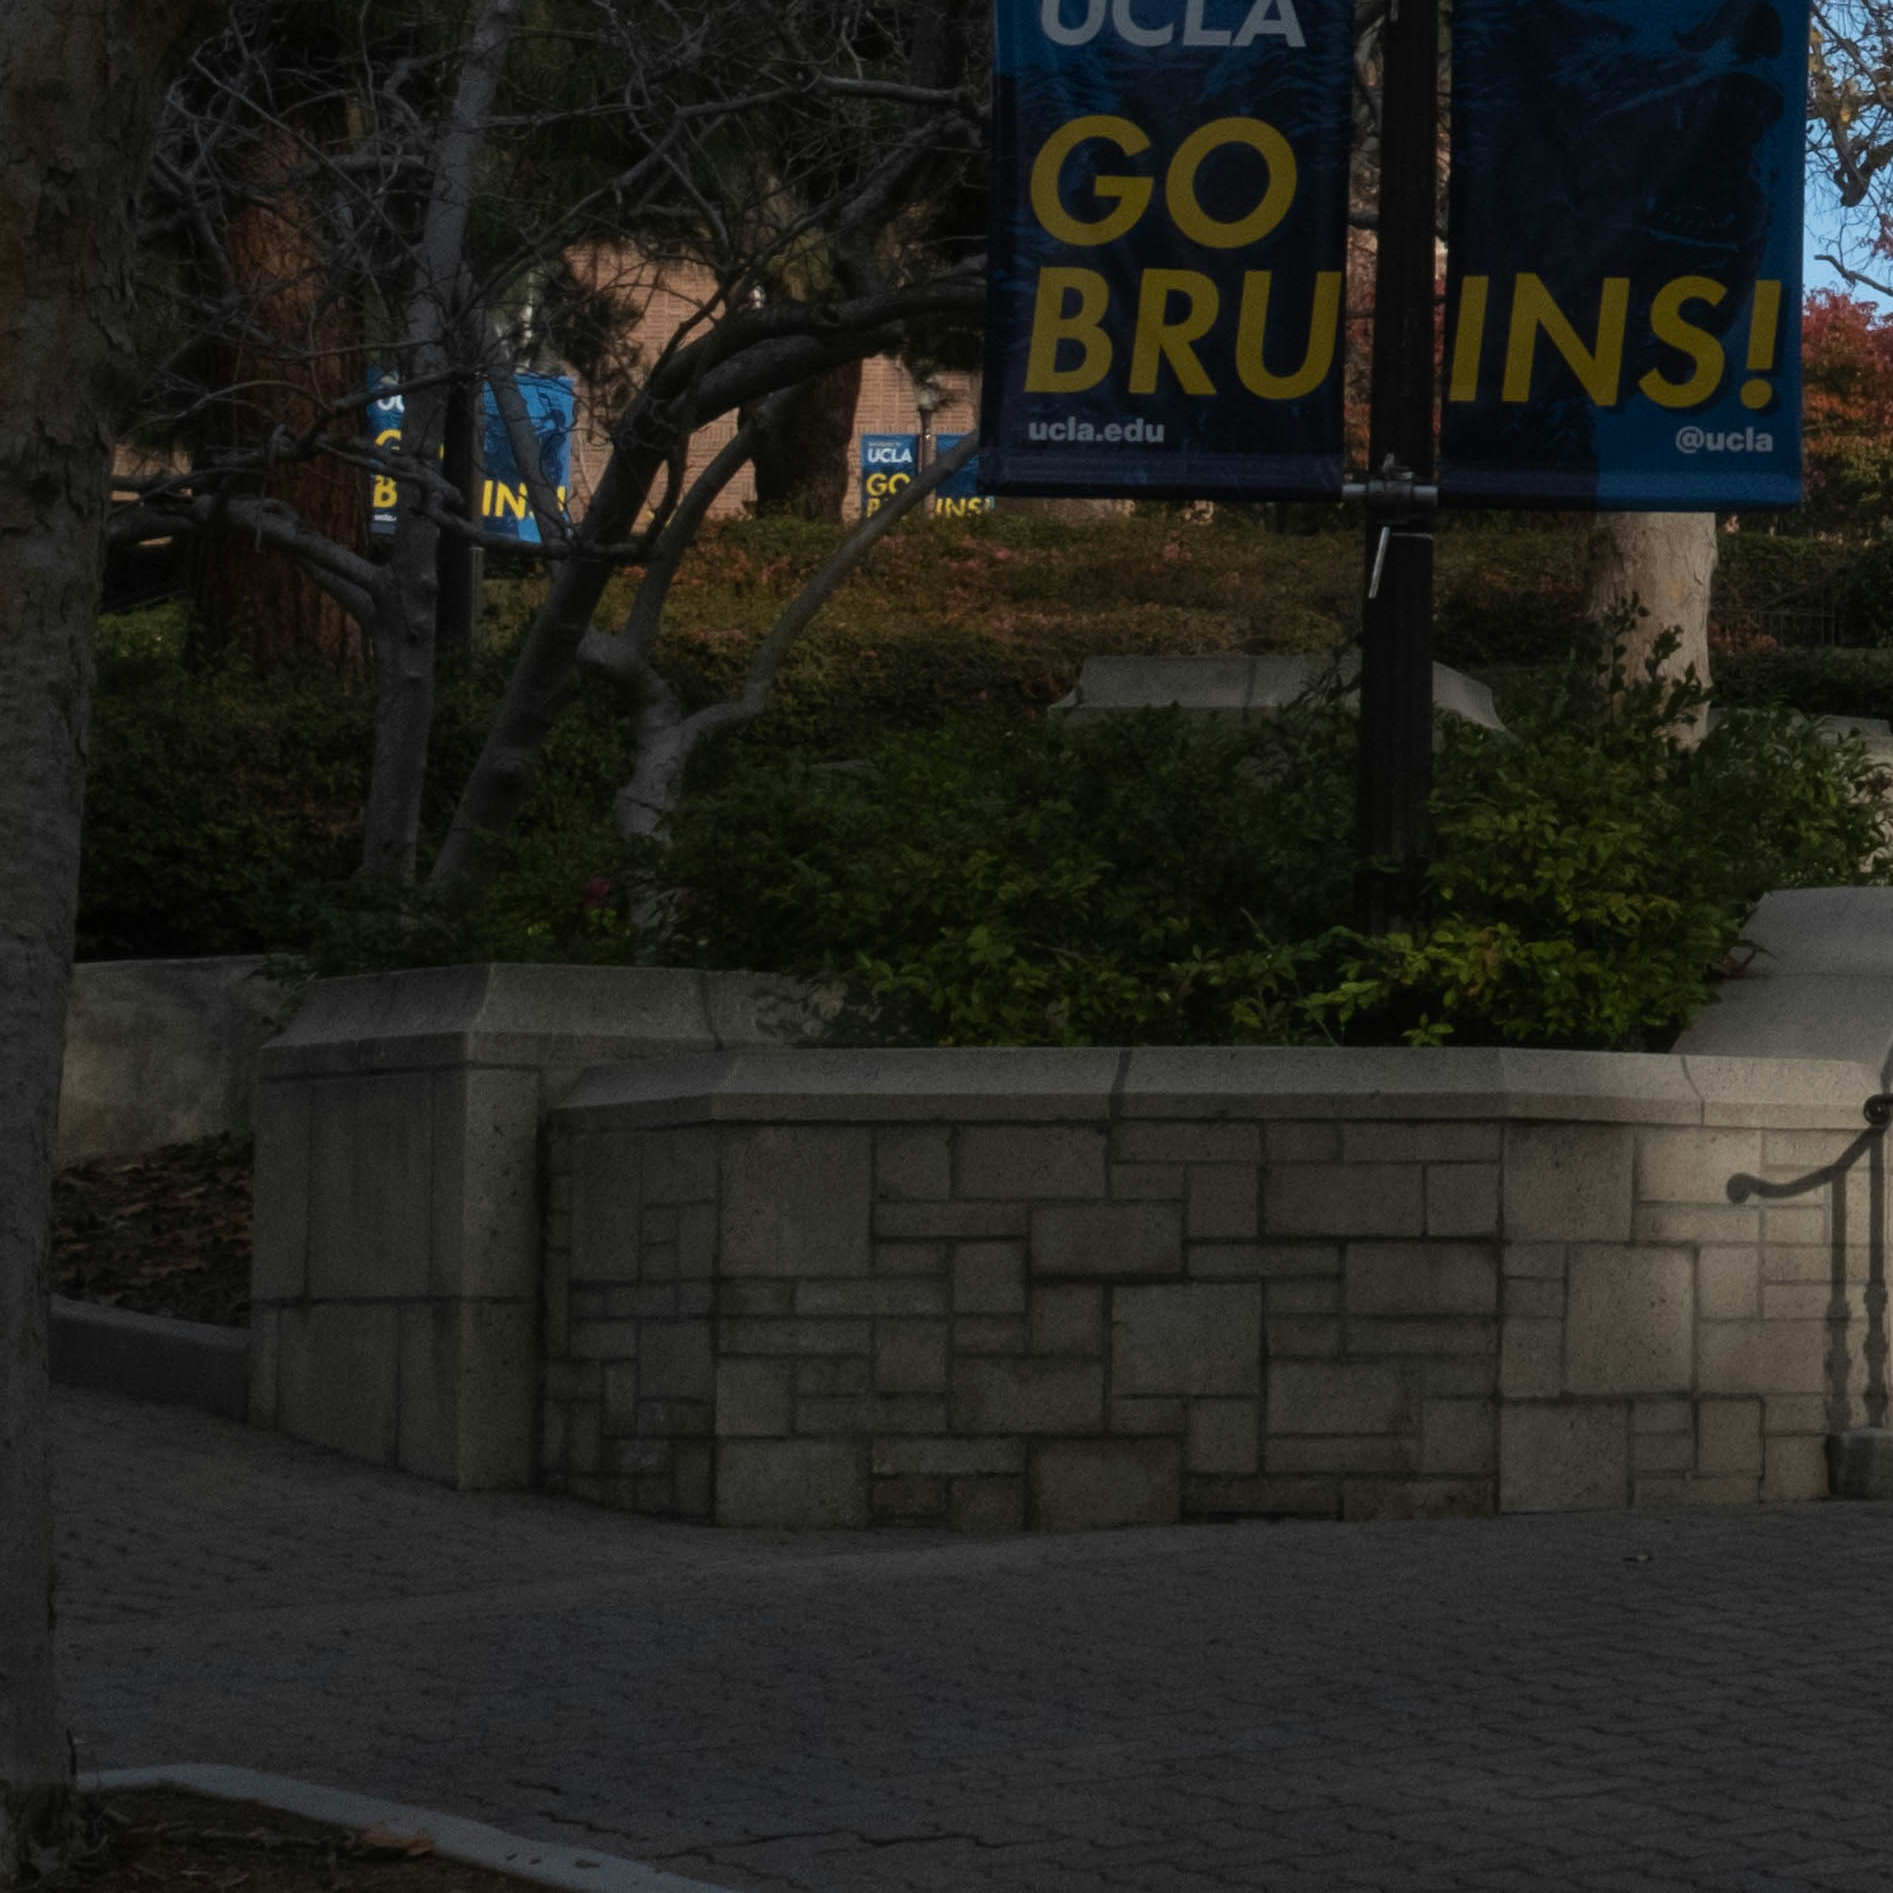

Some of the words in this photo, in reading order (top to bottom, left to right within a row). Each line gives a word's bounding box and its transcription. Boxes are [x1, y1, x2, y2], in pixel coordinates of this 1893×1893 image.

[1030, 114, 1298, 249] GO
[1024, 266, 1343, 401] BRU
[1448, 272, 1782, 410] INS!
[867, 447, 912, 463] UCLA
[1028, 416, 1165, 444] ucla.edu
[1674, 425, 1774, 455] @ucla
